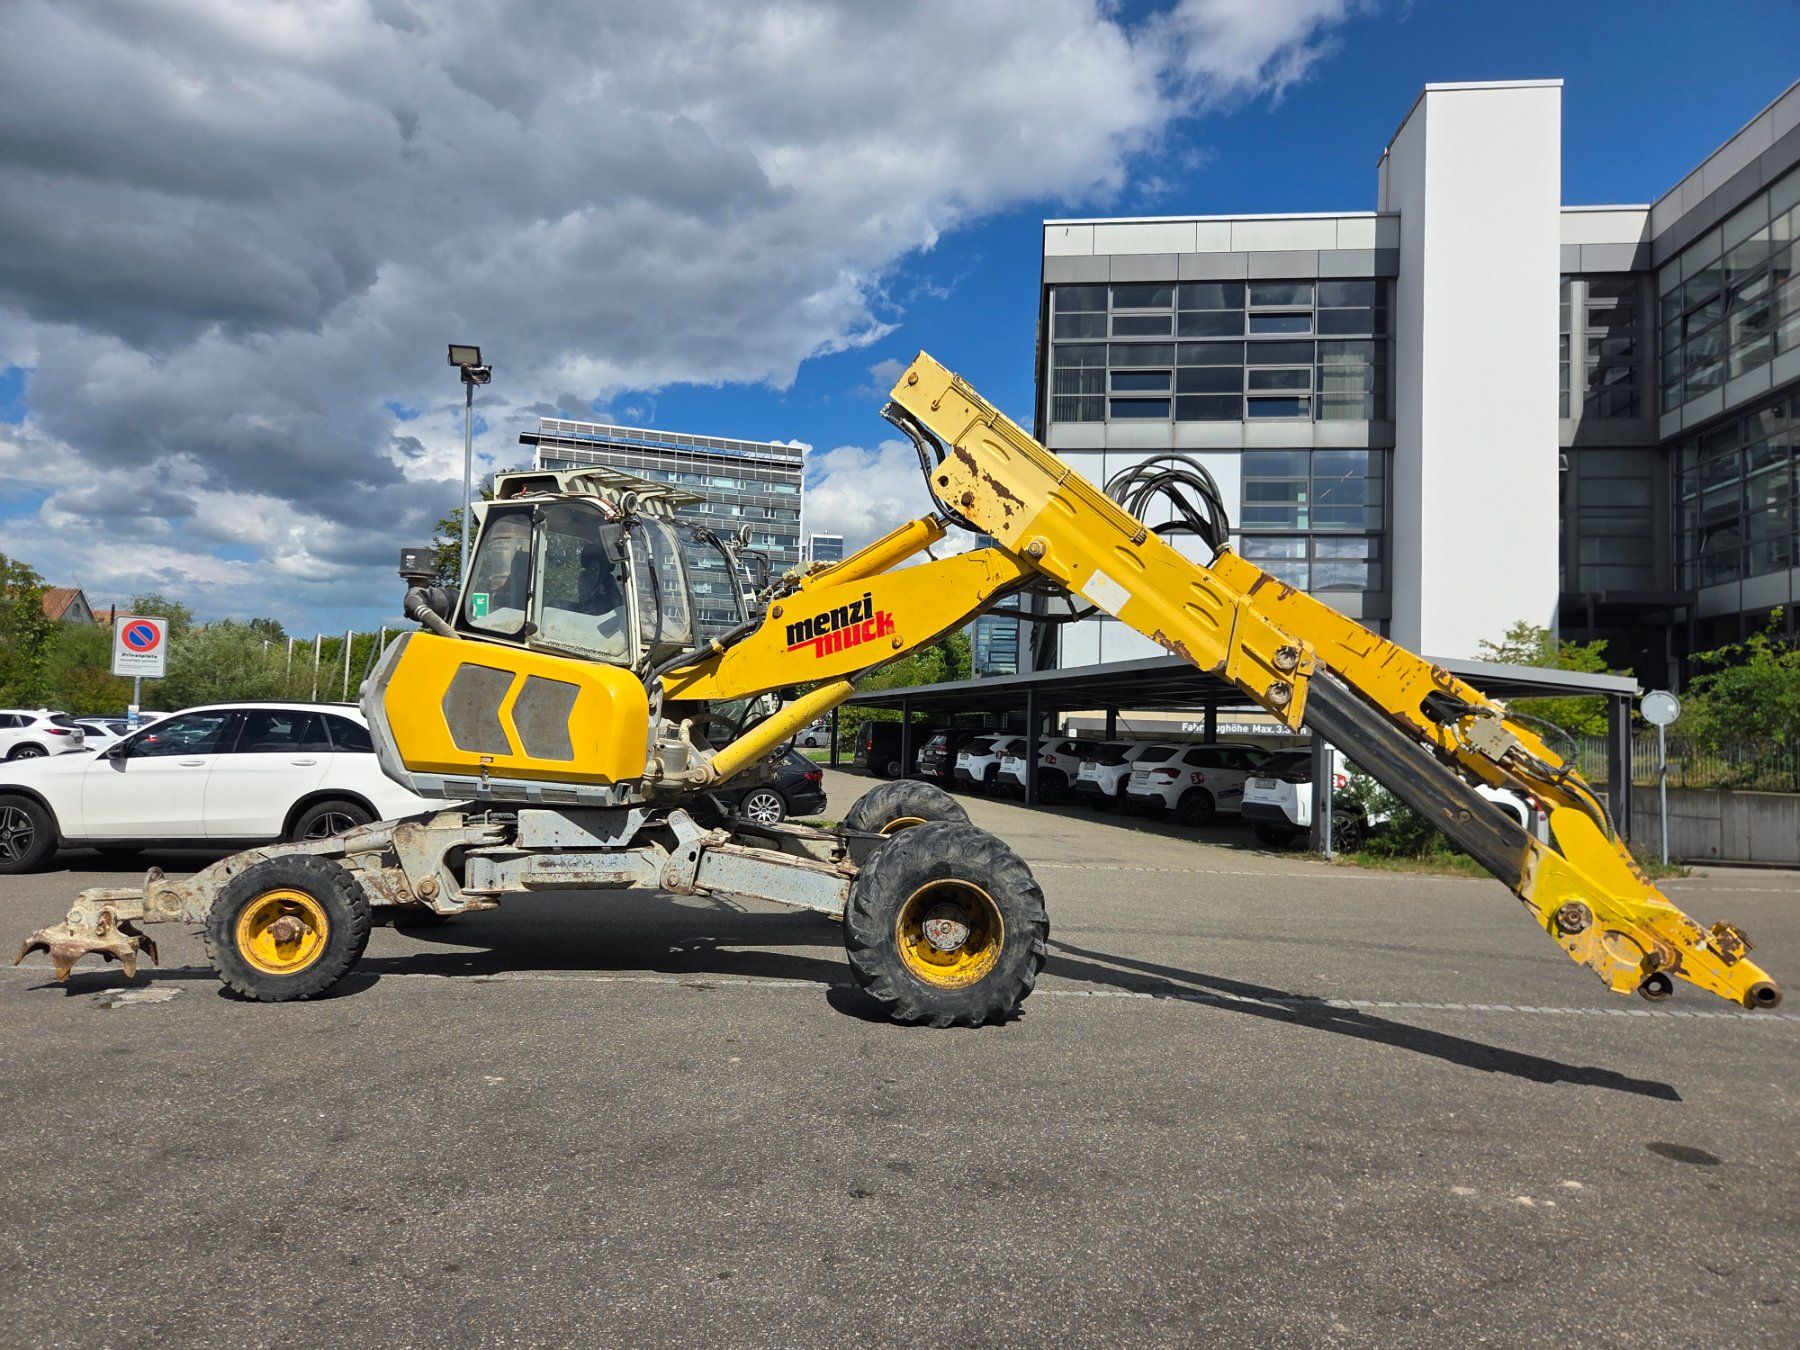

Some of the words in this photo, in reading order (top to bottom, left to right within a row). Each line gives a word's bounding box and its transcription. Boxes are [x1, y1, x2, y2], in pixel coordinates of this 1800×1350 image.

[785, 592, 873, 646] menzi
[815, 610, 895, 658] muck
[1181, 722, 1248, 734] Fahrughöhe
[1252, 724, 1275, 734] Max.
